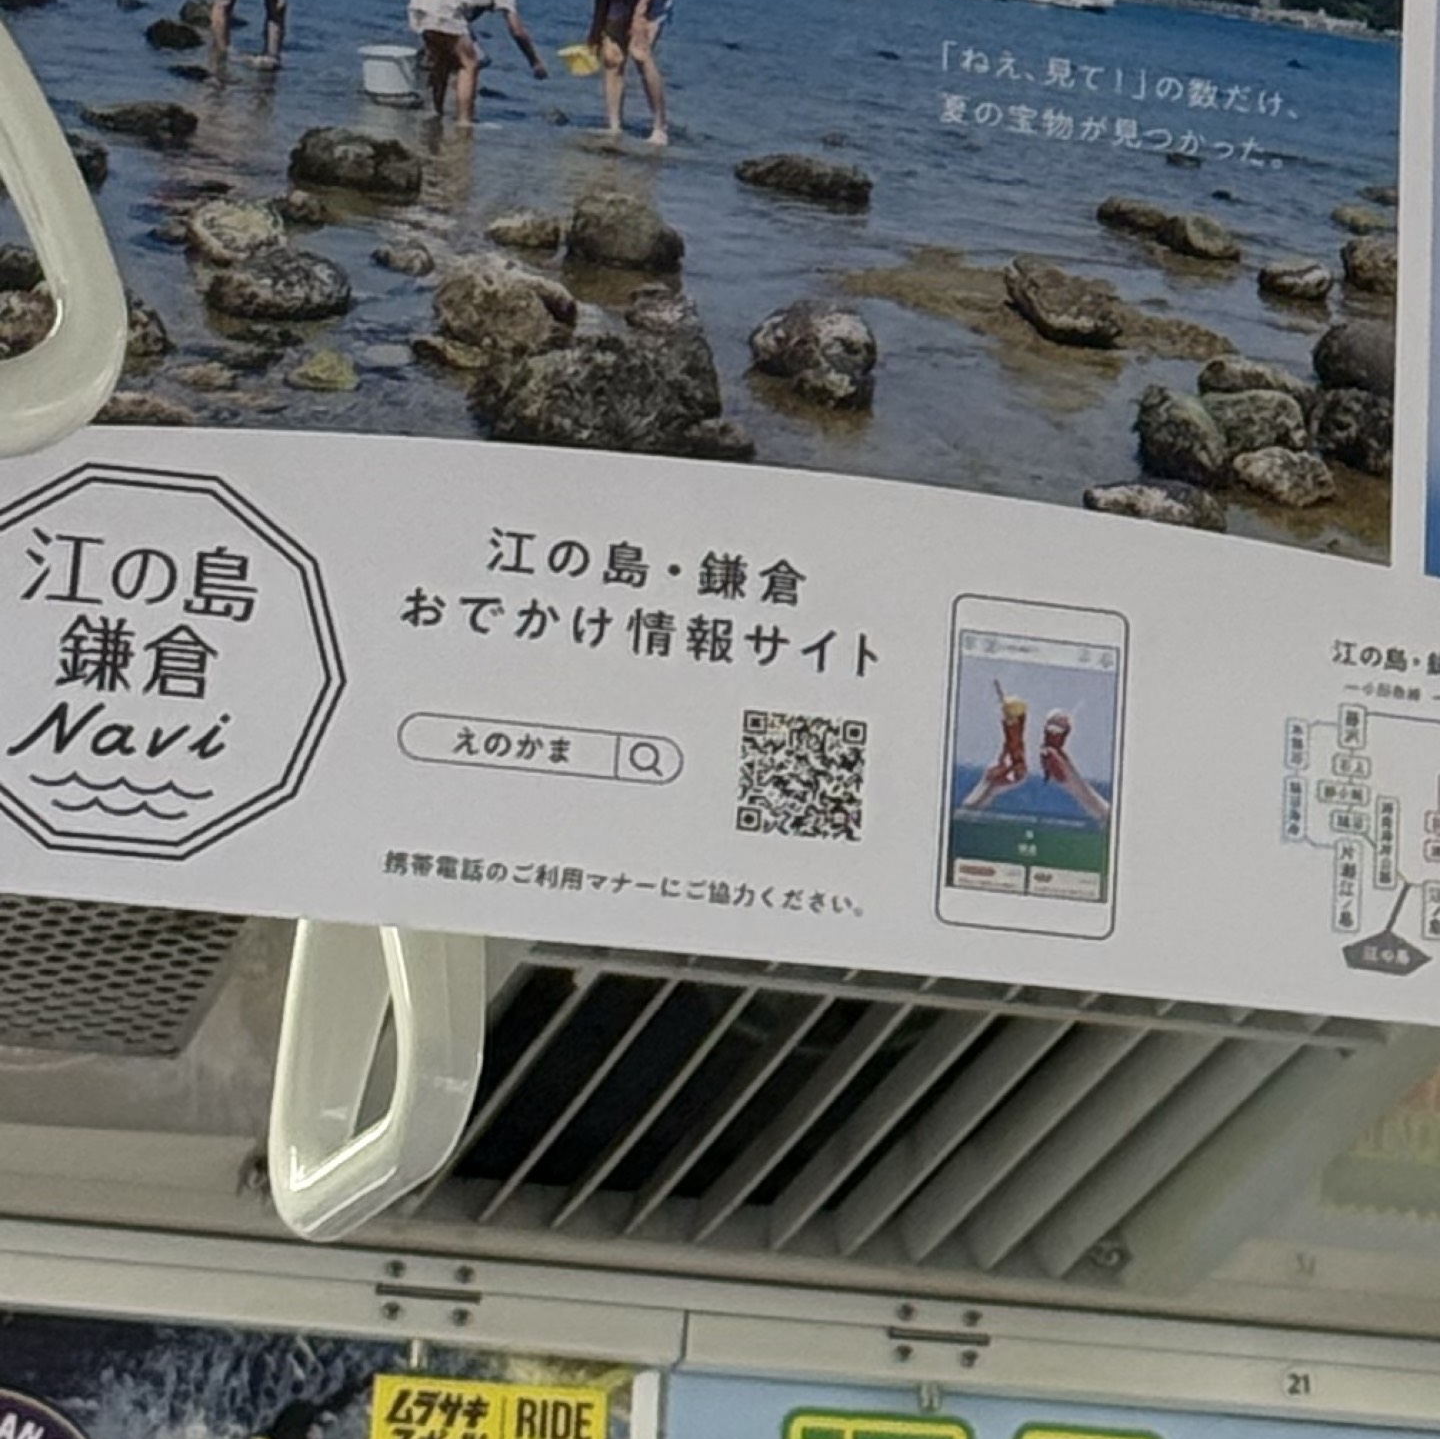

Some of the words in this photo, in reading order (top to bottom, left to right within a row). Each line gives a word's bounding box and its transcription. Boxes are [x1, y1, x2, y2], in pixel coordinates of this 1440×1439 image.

[938, 91, 1283, 171] 夏の宝物が見つかった。
[20, 527, 259, 623] 江の島
[486, 526, 806, 607] 江の島・鎌倉
[54, 615, 219, 700] 鎌倉
[400, 587, 880, 677] おでかけ情報サイト
[7, 701, 232, 760] Navi
[453, 727, 571, 764] えのかま
[382, 849, 866, 918] 携帯電話のご利用マナーにご協力ください。
[386, 1389, 490, 1428] ムラサキ
[1287, 1372, 1310, 1395] 21
